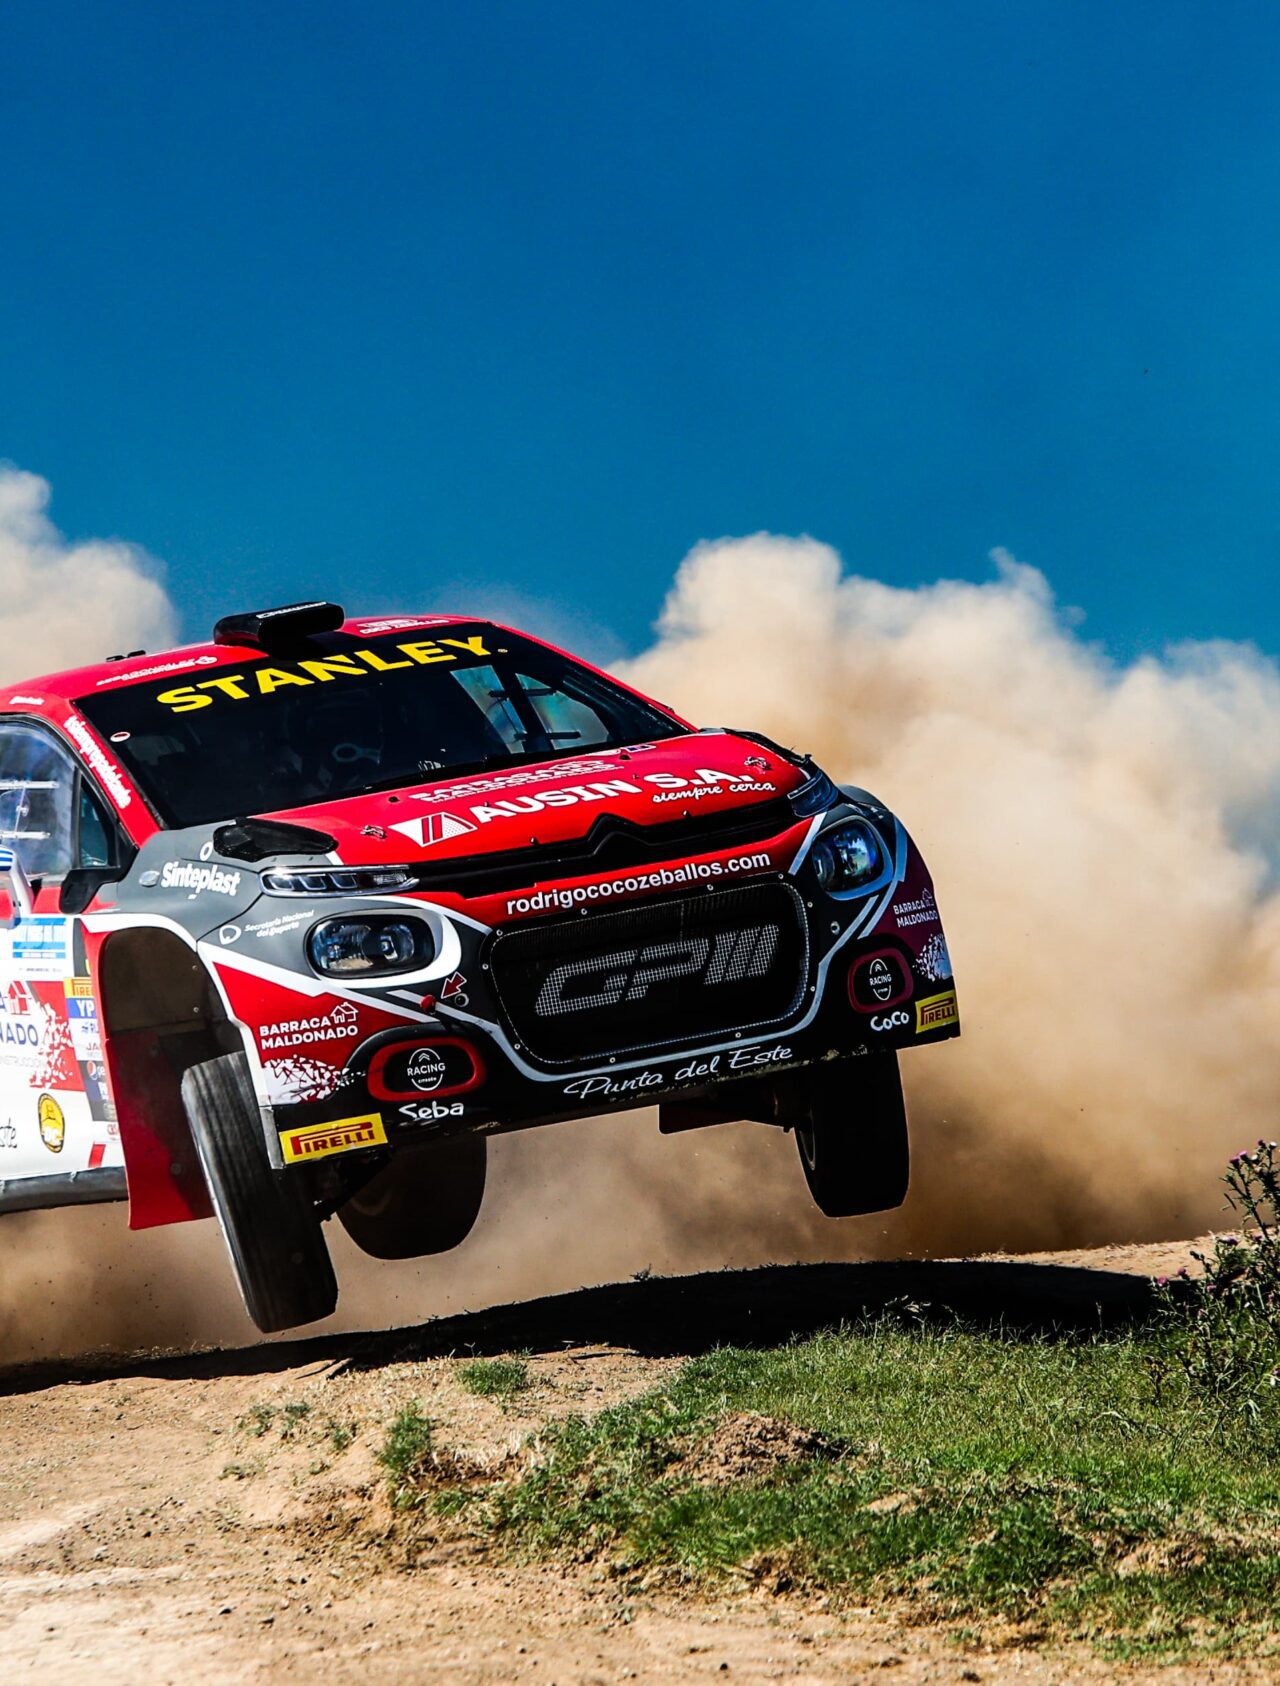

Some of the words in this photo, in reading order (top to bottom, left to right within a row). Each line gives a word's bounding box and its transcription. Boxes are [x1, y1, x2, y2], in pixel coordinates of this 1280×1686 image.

[156, 636, 492, 713] STANLEY
[470, 779, 643, 825] AUSIN
[643, 768, 755, 790] S.A.
[652, 784, 723, 804] siempre
[729, 781, 776, 793] cerca
[160, 861, 241, 896] Sinteplast
[506, 852, 771, 915] rodrigococozeballos.com
[893, 900, 927, 915] BARRACA
[896, 910, 939, 928] MALDONADO
[869, 974, 892, 986] RACING
[920, 996, 955, 1027] PIRELLI
[260, 1016, 331, 1037] BARRACA
[260, 1025, 358, 1050] MALDONADO
[406, 1062, 446, 1077] RACING
[563, 1070, 664, 1099] Punta
[674, 1055, 720, 1080] del
[728, 1045, 794, 1069] Este
[398, 1100, 464, 1120] Seba
[290, 1121, 375, 1156] PIRELLI
